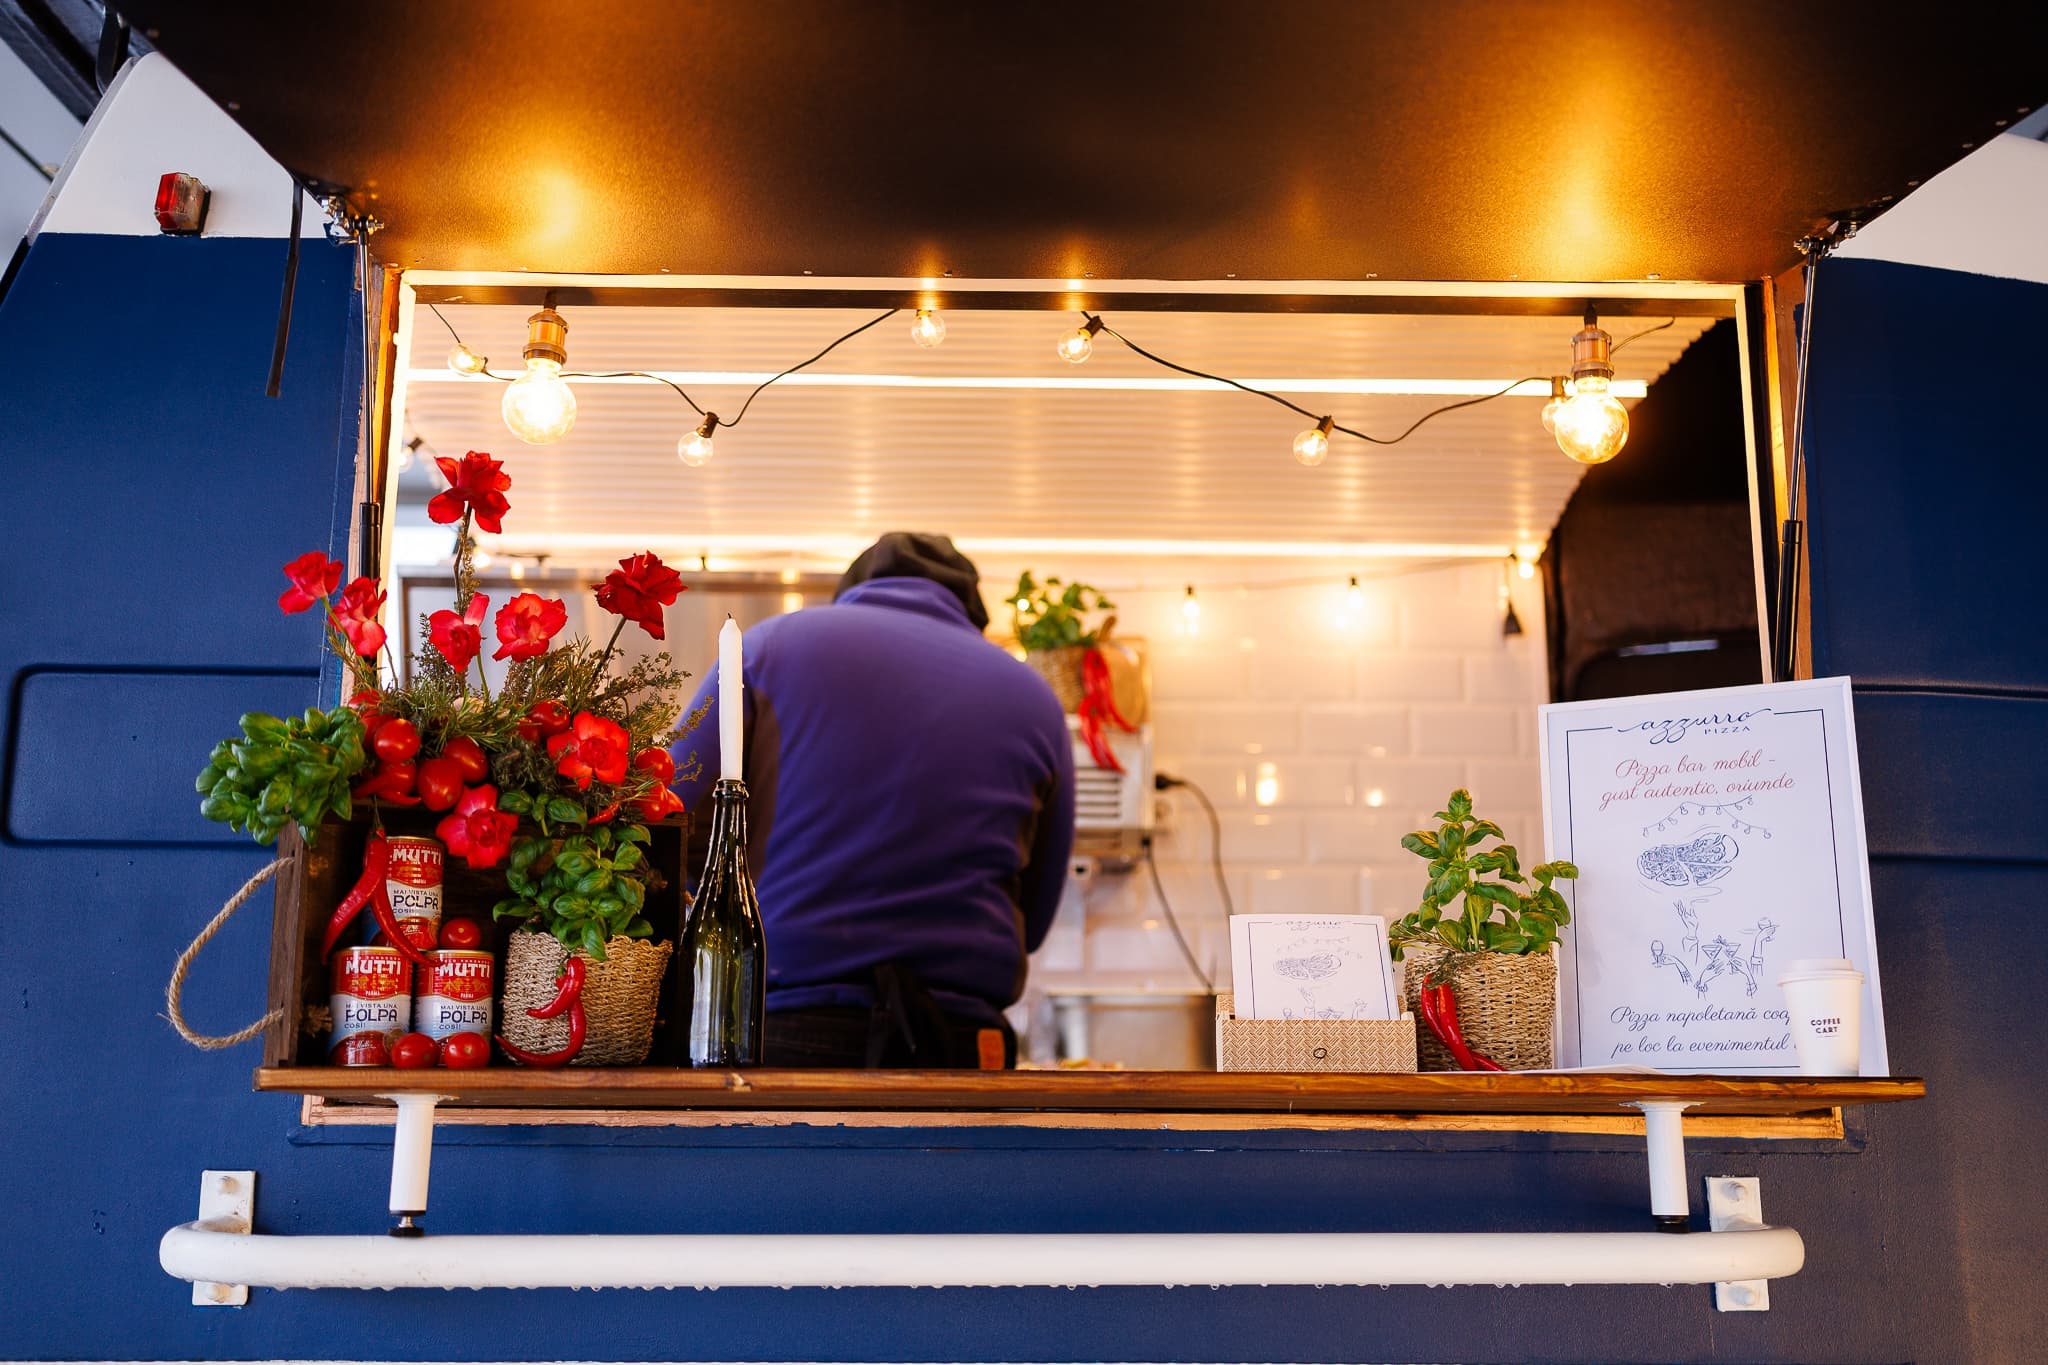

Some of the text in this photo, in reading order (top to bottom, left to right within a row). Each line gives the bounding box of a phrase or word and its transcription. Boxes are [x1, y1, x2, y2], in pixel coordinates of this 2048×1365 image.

[1618, 708, 1771, 744] azzurro
[1705, 726, 1751, 735] PIZZA
[1615, 759, 1671, 785] Pizza
[1677, 754, 1705, 774] bar
[1714, 749, 1764, 772] mobil
[1599, 785, 1639, 811] gust
[1726, 772, 1795, 794] oriunde
[393, 849, 442, 865] MUTTI
[393, 894, 439, 910] POLPA
[345, 959, 401, 975] MUTTI
[440, 962, 490, 978] MUTTI
[345, 1009, 398, 1022] POLPA
[440, 1010, 488, 1024] POLPA
[1611, 1003, 1790, 1031] Pizza napoletană coa
[1810, 1018, 1840, 1026] COFFEE
[1610, 1033, 1790, 1059] pe loc la evenimentul
